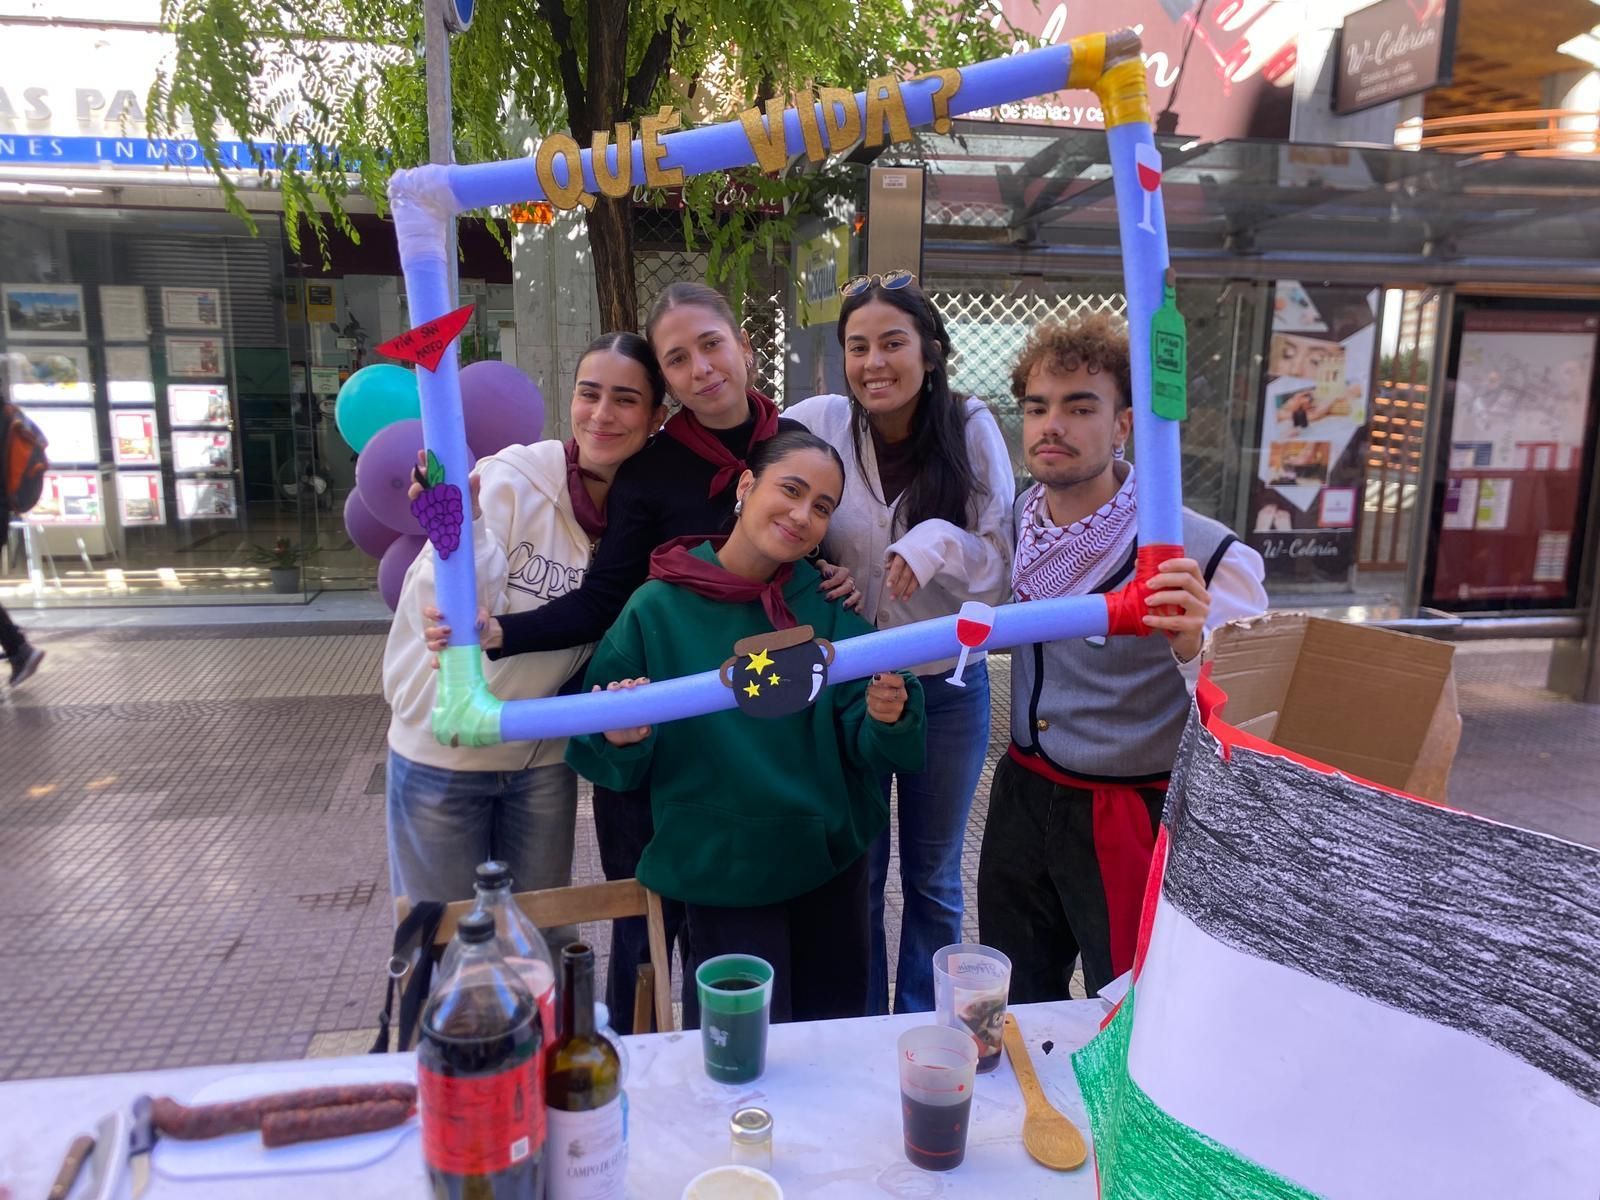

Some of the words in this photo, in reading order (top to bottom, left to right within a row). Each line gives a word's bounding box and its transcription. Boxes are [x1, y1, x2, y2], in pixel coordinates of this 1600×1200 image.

[535, 105, 685, 212] QUÉ
[739, 68, 963, 174] VIDA?
[1073, 106, 1085, 125] y
